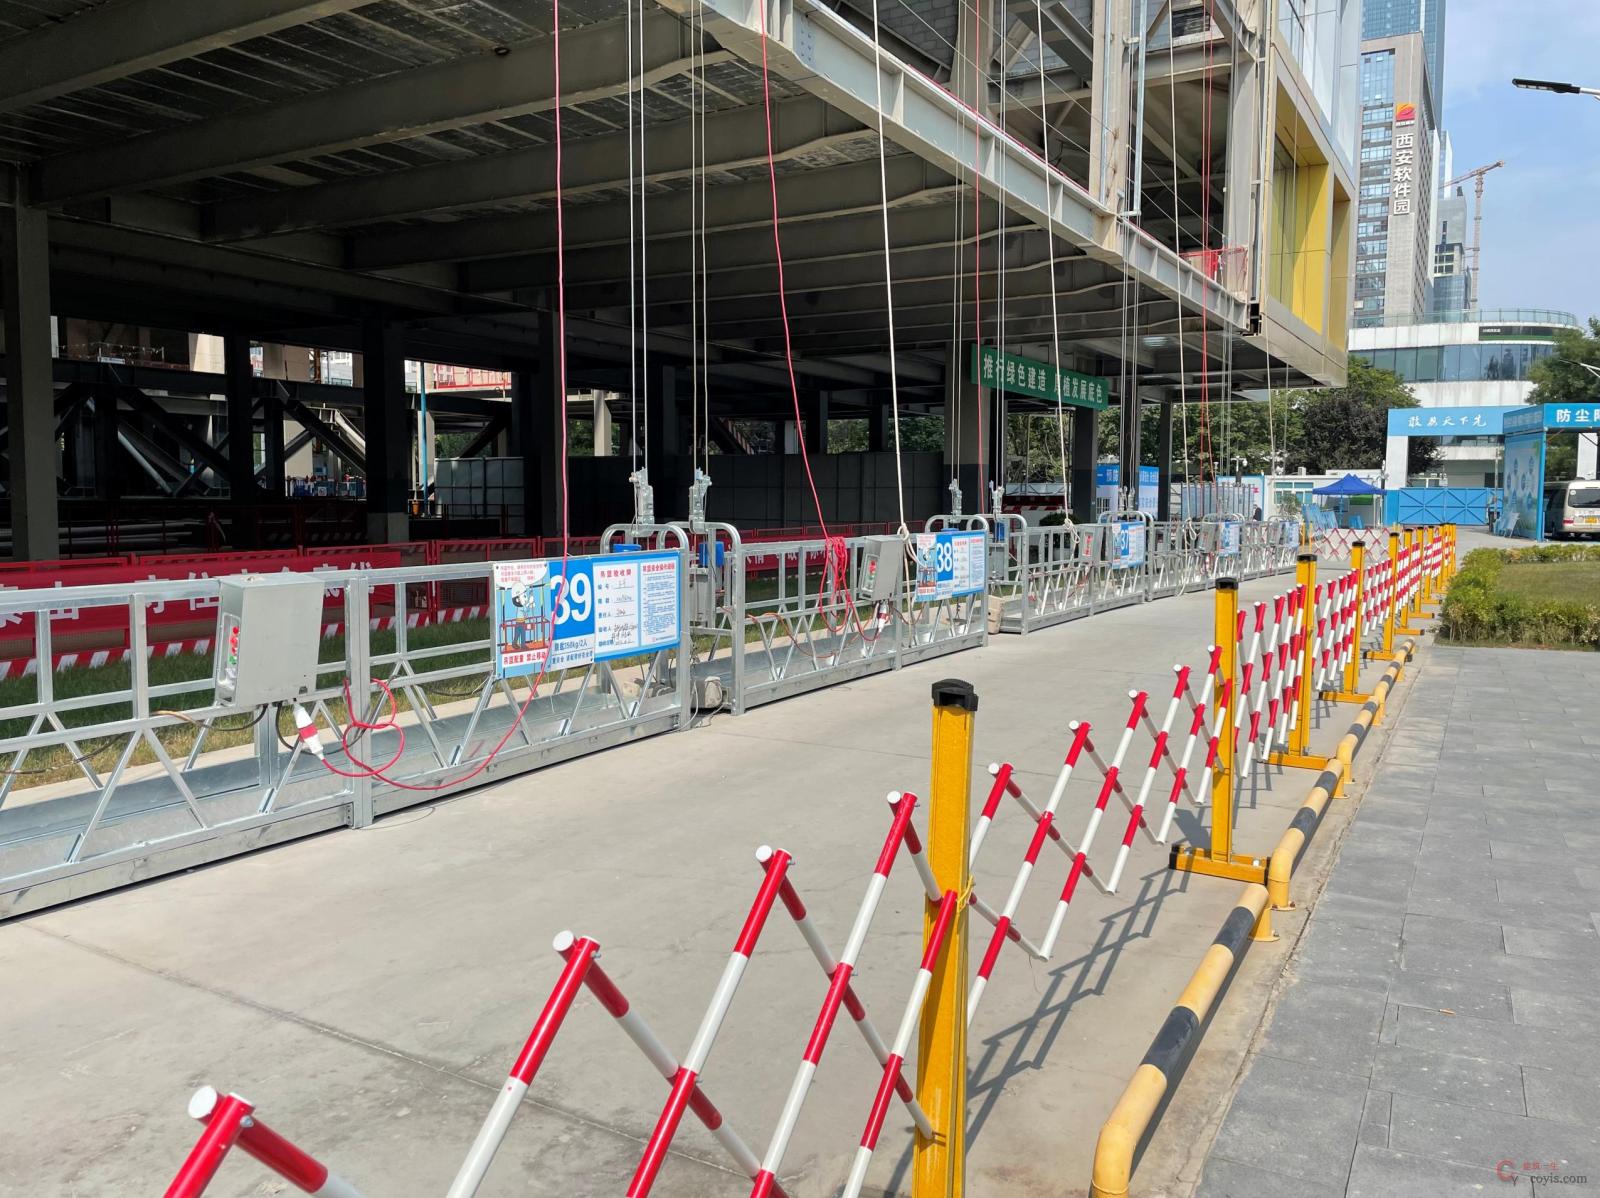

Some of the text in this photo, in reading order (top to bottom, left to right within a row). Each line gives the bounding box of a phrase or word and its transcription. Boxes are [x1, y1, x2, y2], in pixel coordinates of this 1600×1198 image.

[1393, 133, 1414, 215] 西安软件园
[936, 542, 952, 572] 38
[550, 572, 592, 625] 39
